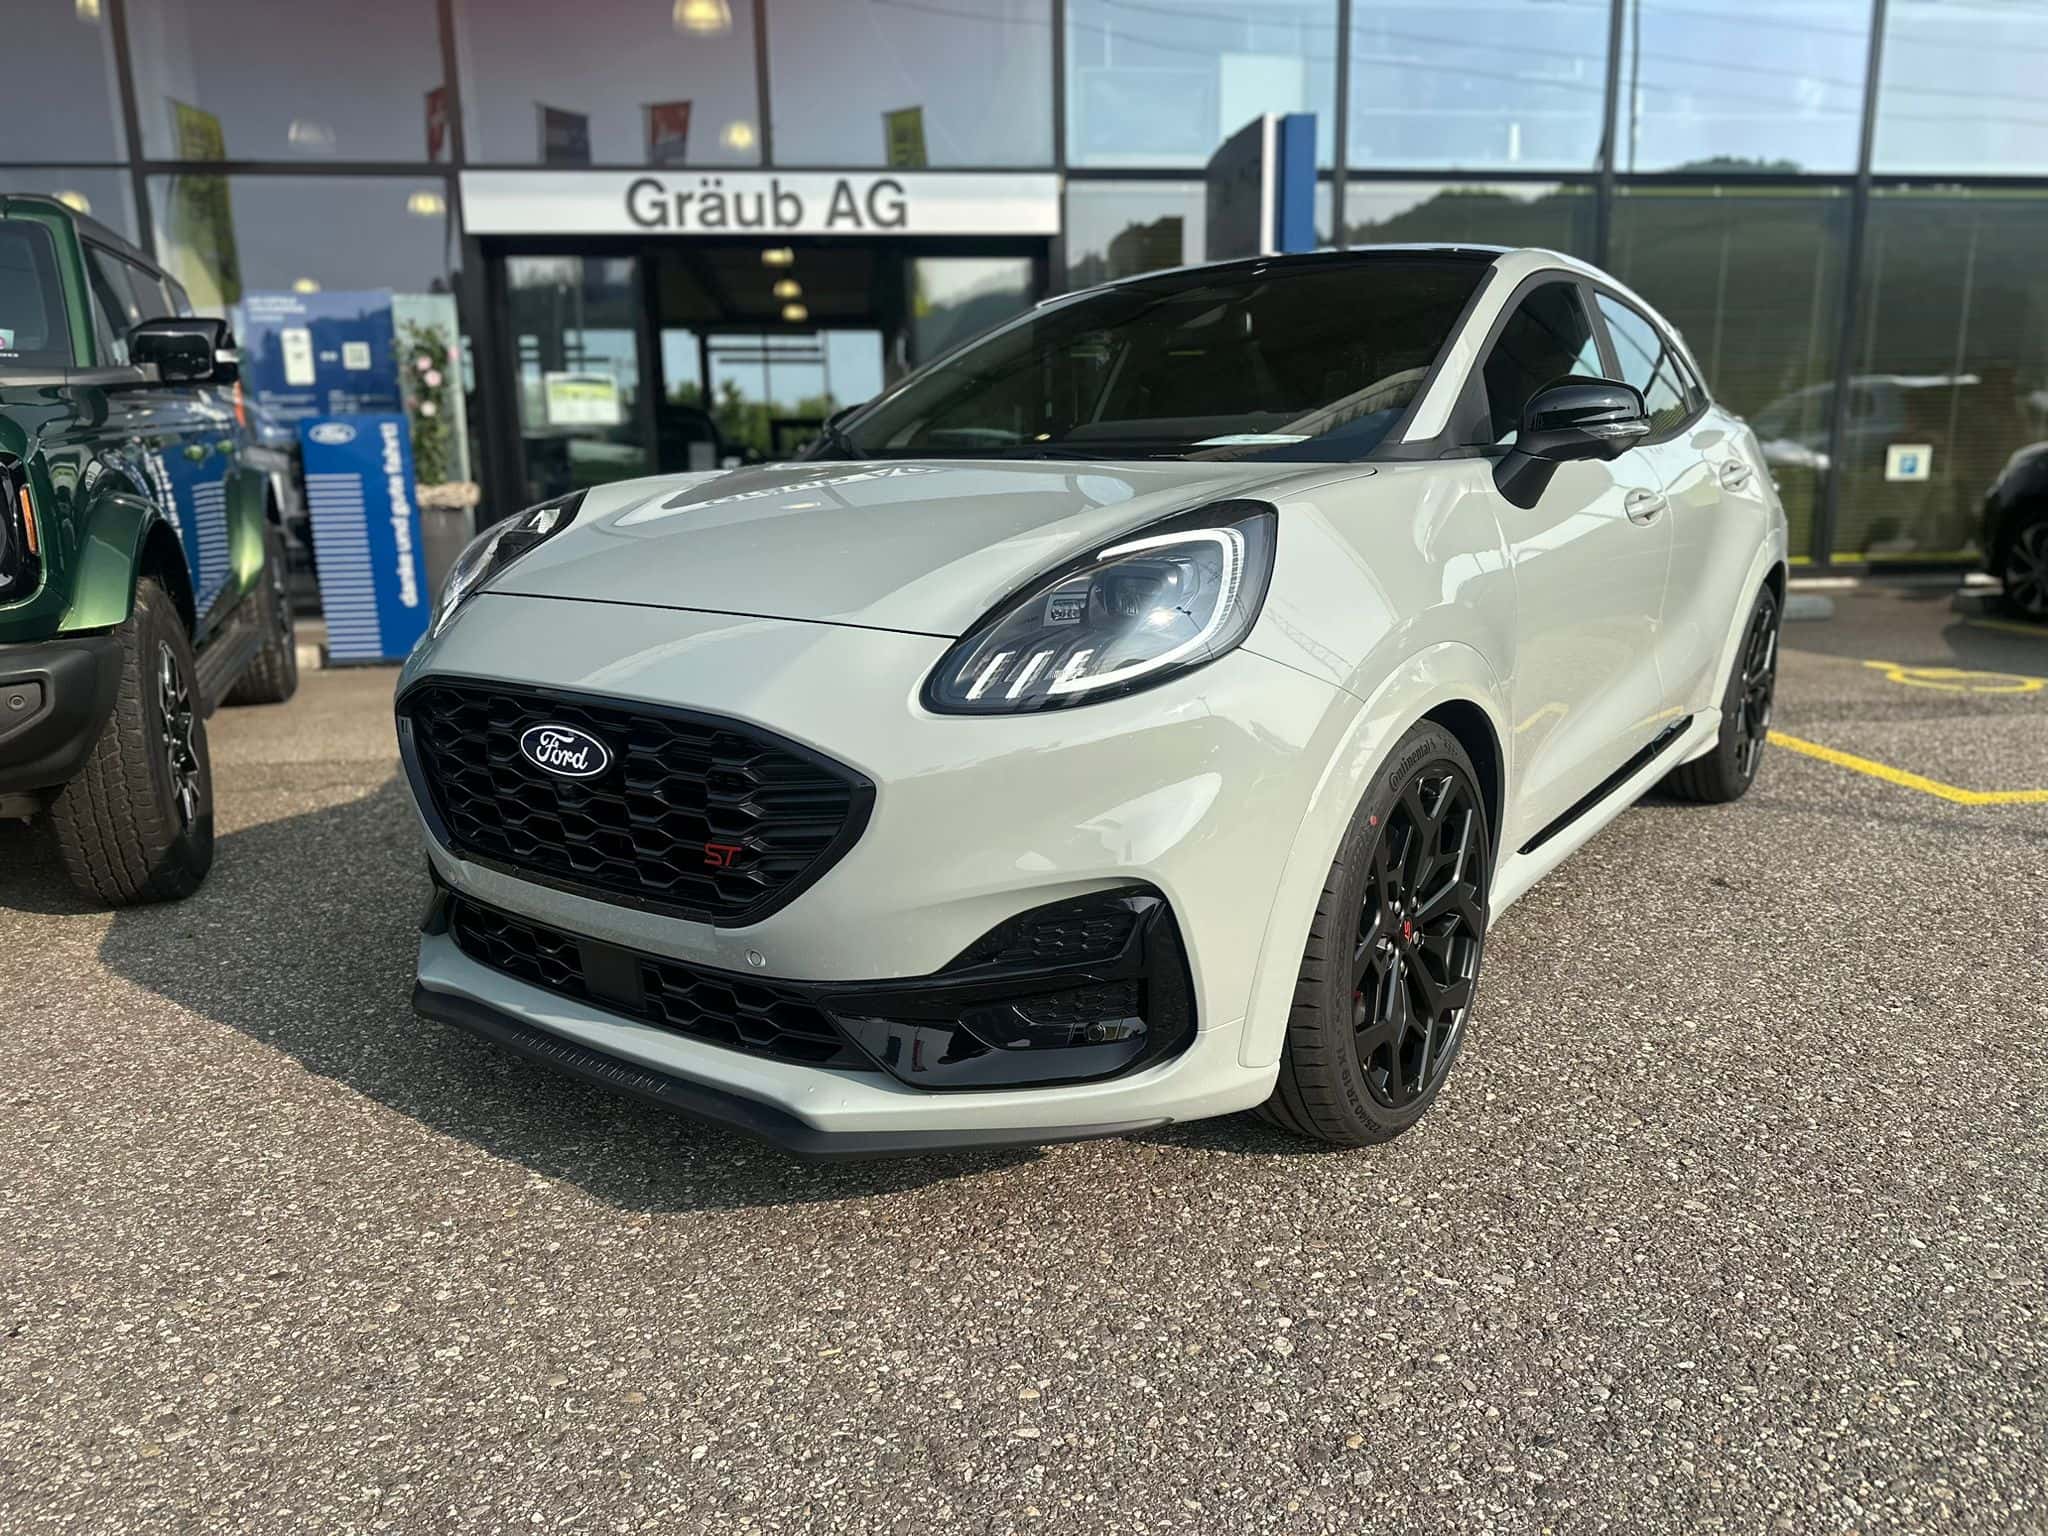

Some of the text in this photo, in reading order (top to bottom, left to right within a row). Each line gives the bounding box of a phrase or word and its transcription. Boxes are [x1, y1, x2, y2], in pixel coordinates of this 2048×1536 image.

[625, 177, 908, 228] Gräub AG
[536, 731, 589, 769] Ford
[1389, 739, 1431, 793] Continental
[704, 843, 742, 866] ST
